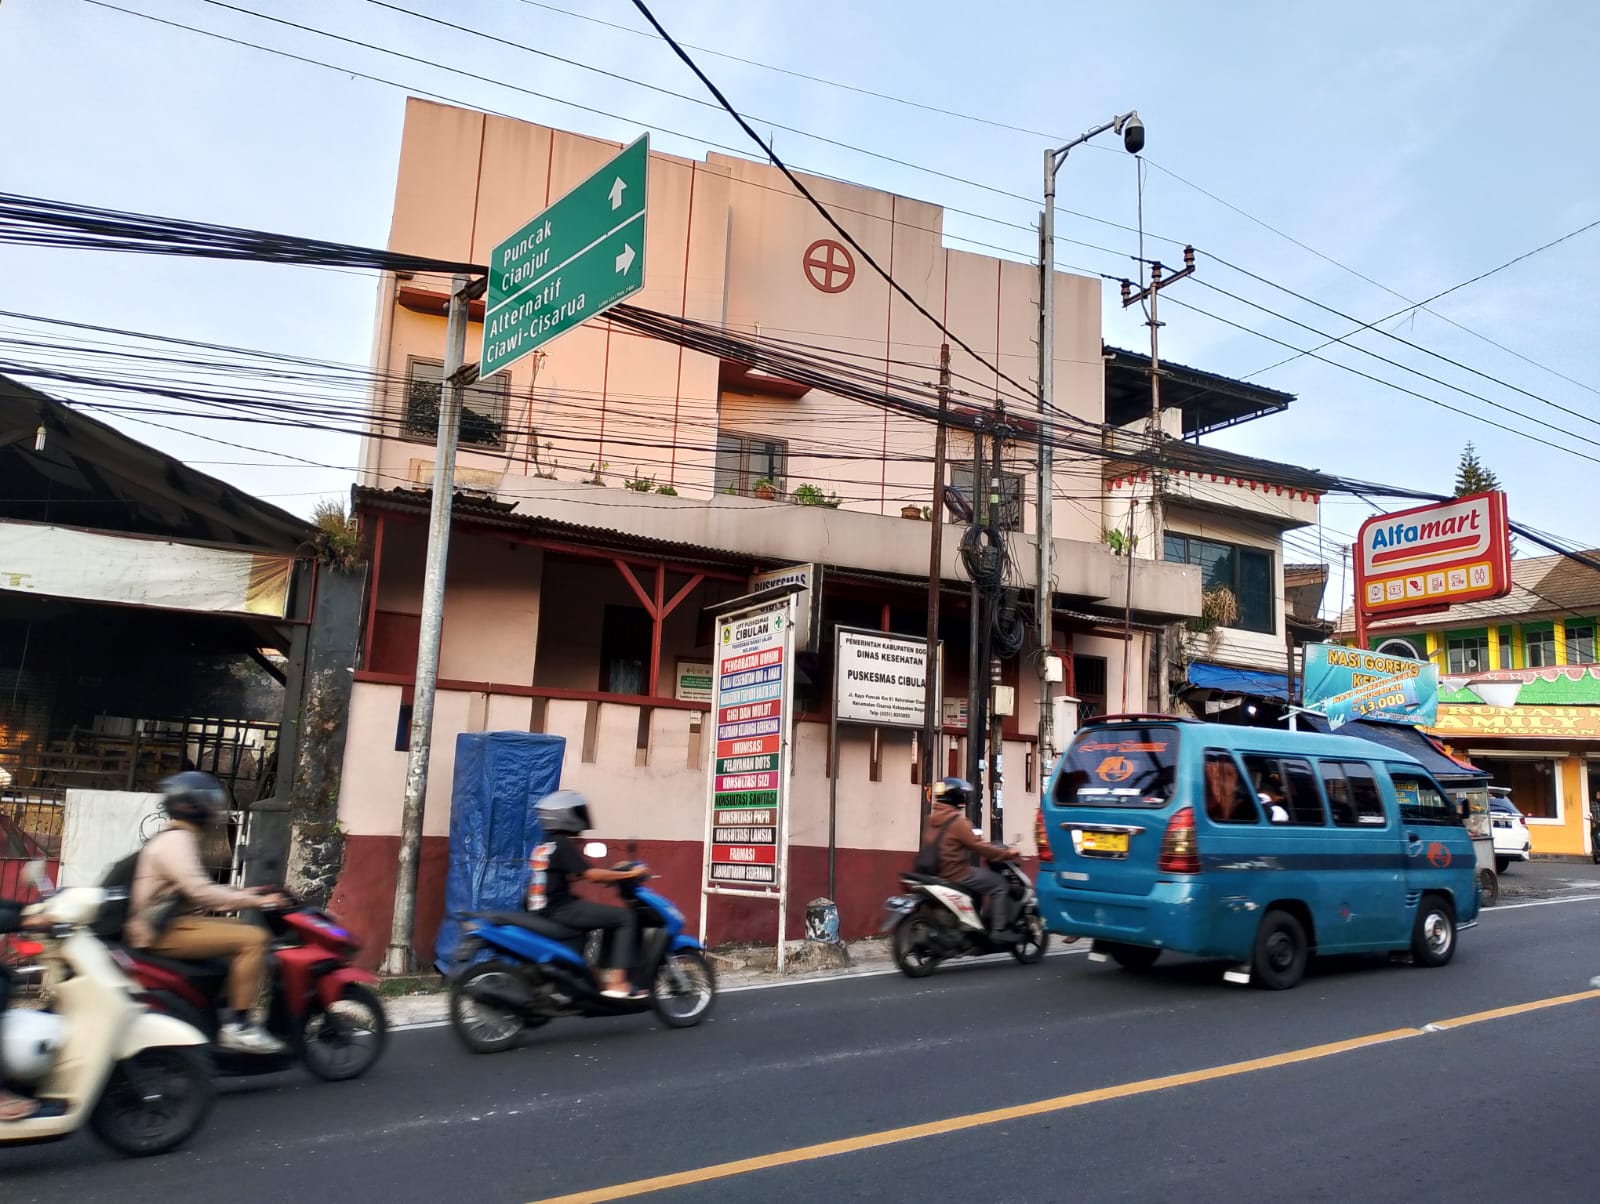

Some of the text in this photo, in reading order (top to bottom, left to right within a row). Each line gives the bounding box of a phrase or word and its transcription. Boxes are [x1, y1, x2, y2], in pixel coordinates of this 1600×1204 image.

[503, 219, 552, 267] Puncak
[501, 247, 550, 292] Cianjur
[489, 276, 562, 338] Alternatif
[486, 292, 586, 363] Ciawi-Cisarua
[1372, 509, 1481, 550] Alfamart
[735, 623, 769, 640] CIBULAN
[845, 638, 881, 648] PEMERINTAH
[882, 643, 914, 653] KABUPATEN
[724, 653, 759, 673] PENGOBATAN
[857, 650, 923, 666] DINAS KESEHATAN
[1328, 649, 1420, 678] NASI GORENG
[847, 669, 926, 688] PUSKESMAS CIBULA
[726, 702, 772, 722] GIGI DAN MULUT
[1448, 706, 1578, 717] RUMAH
[1436, 715, 1584, 728] AMILY
[1483, 727, 1595, 735] MASAKAN
[732, 739, 763, 755] IMUNISASI
[723, 755, 771, 773] PELAYANAN DOTS
[722, 774, 770, 789] KONSULTASI GIZI
[715, 791, 777, 807] KONSULTASI SANITASI
[719, 810, 753, 824] KONSULTASI
[716, 828, 773, 843] KONSULTASI LANSIA
[730, 847, 756, 861] FARMASI
